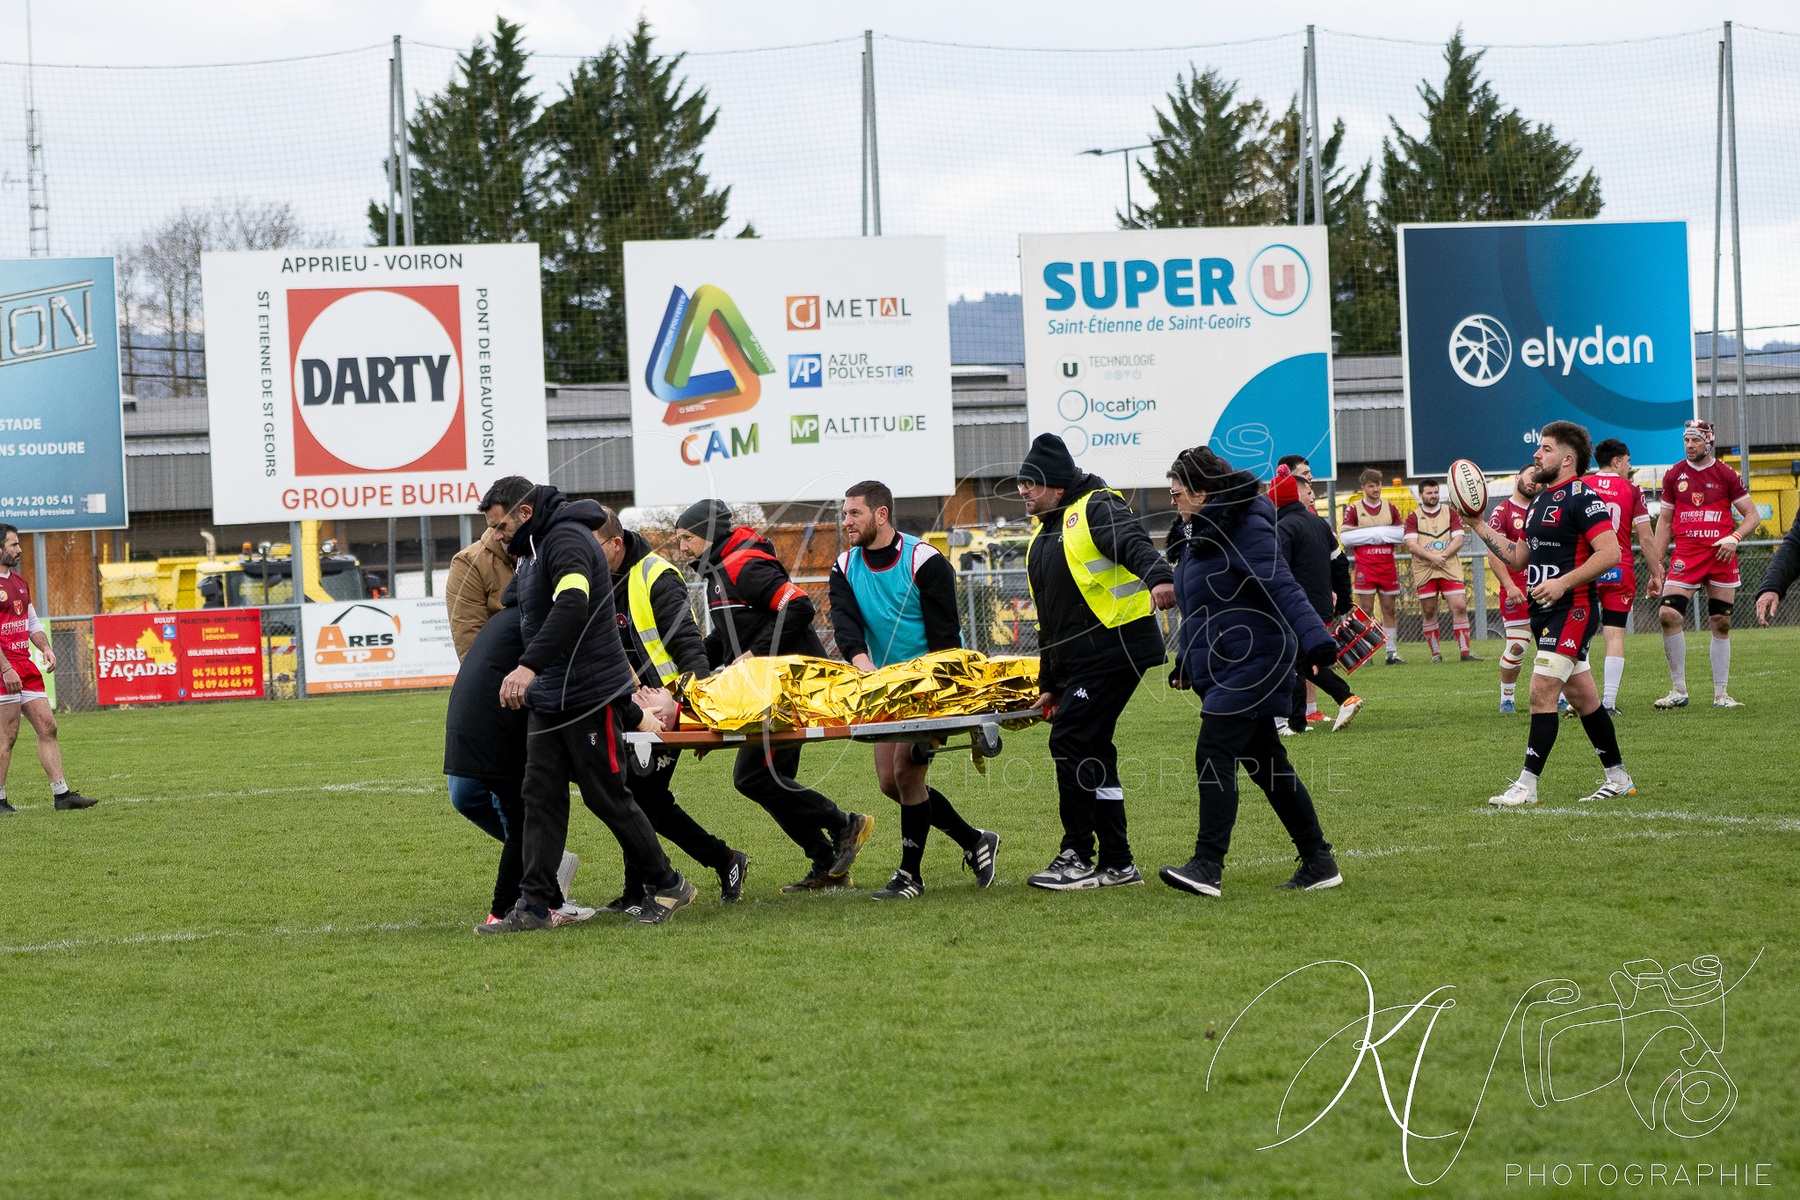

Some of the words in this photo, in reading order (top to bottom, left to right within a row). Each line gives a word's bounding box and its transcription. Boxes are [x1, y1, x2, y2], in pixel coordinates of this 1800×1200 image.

[281, 256, 367, 273] APPRIEU
[384, 253, 463, 270] VOIRON
[1043, 257, 1237, 311] SUPER
[1262, 264, 1296, 301] U
[257, 291, 270, 310] ST
[826, 297, 912, 318] METAL
[476, 288, 490, 334] PONT
[1048, 314, 1143, 335] Saint-Étienne
[1147, 316, 1165, 332] de
[1168, 313, 1252, 332] Saint-Geoirs
[258, 314, 271, 375] ETIENNE
[479, 338, 491, 360] DE
[1521, 325, 1654, 376] elydan
[828, 354, 868, 367] AZUR
[1062, 362, 1079, 378] U
[1088, 354, 1156, 368] TECHNOLOGIE
[301, 355, 452, 406] DARTY
[828, 365, 914, 380] POLYESTER
[261, 379, 273, 399] DE
[263, 402, 274, 419] ST
[1090, 397, 1157, 413] location
[0, 418, 42, 431] STADE
[480, 365, 495, 466] BEAUVOISIN
[824, 415, 926, 434] ALTITUDE
[18, 441, 85, 456] SOUDURE
[680, 422, 760, 467] CAM
[1091, 432, 1142, 447] DRIVE
[264, 422, 276, 478] GEOIRS
[1460, 463, 1481, 507] GILBERT
[1, 496, 15, 507] 04
[16, 496, 29, 506] 74
[31, 495, 44, 506] 20
[45, 495, 59, 505] 05
[60, 494, 74, 505] 41
[282, 485, 393, 510] GROUPE
[6, 508, 28, 517] Pierre
[29, 507, 39, 516] de
[39, 506, 75, 516] Bressieux
[1, 621, 26, 630] FITNESS
[316, 625, 394, 649] ARES
[97, 643, 147, 662] ISÈRE
[187, 648, 214, 657] ISOLATION
[343, 649, 372, 663] TP
[98, 662, 177, 682] FAÇADES
[192, 668, 204, 678] 04
[205, 667, 217, 677] 74
[217, 666, 229, 676] 58
[229, 666, 241, 676] 68
[241, 665, 254, 675] 75
[193, 680, 205, 690] 06
[205, 680, 217, 689] 09
[217, 679, 229, 688] 46
[230, 679, 242, 688] 46
[242, 677, 254, 687] 99
